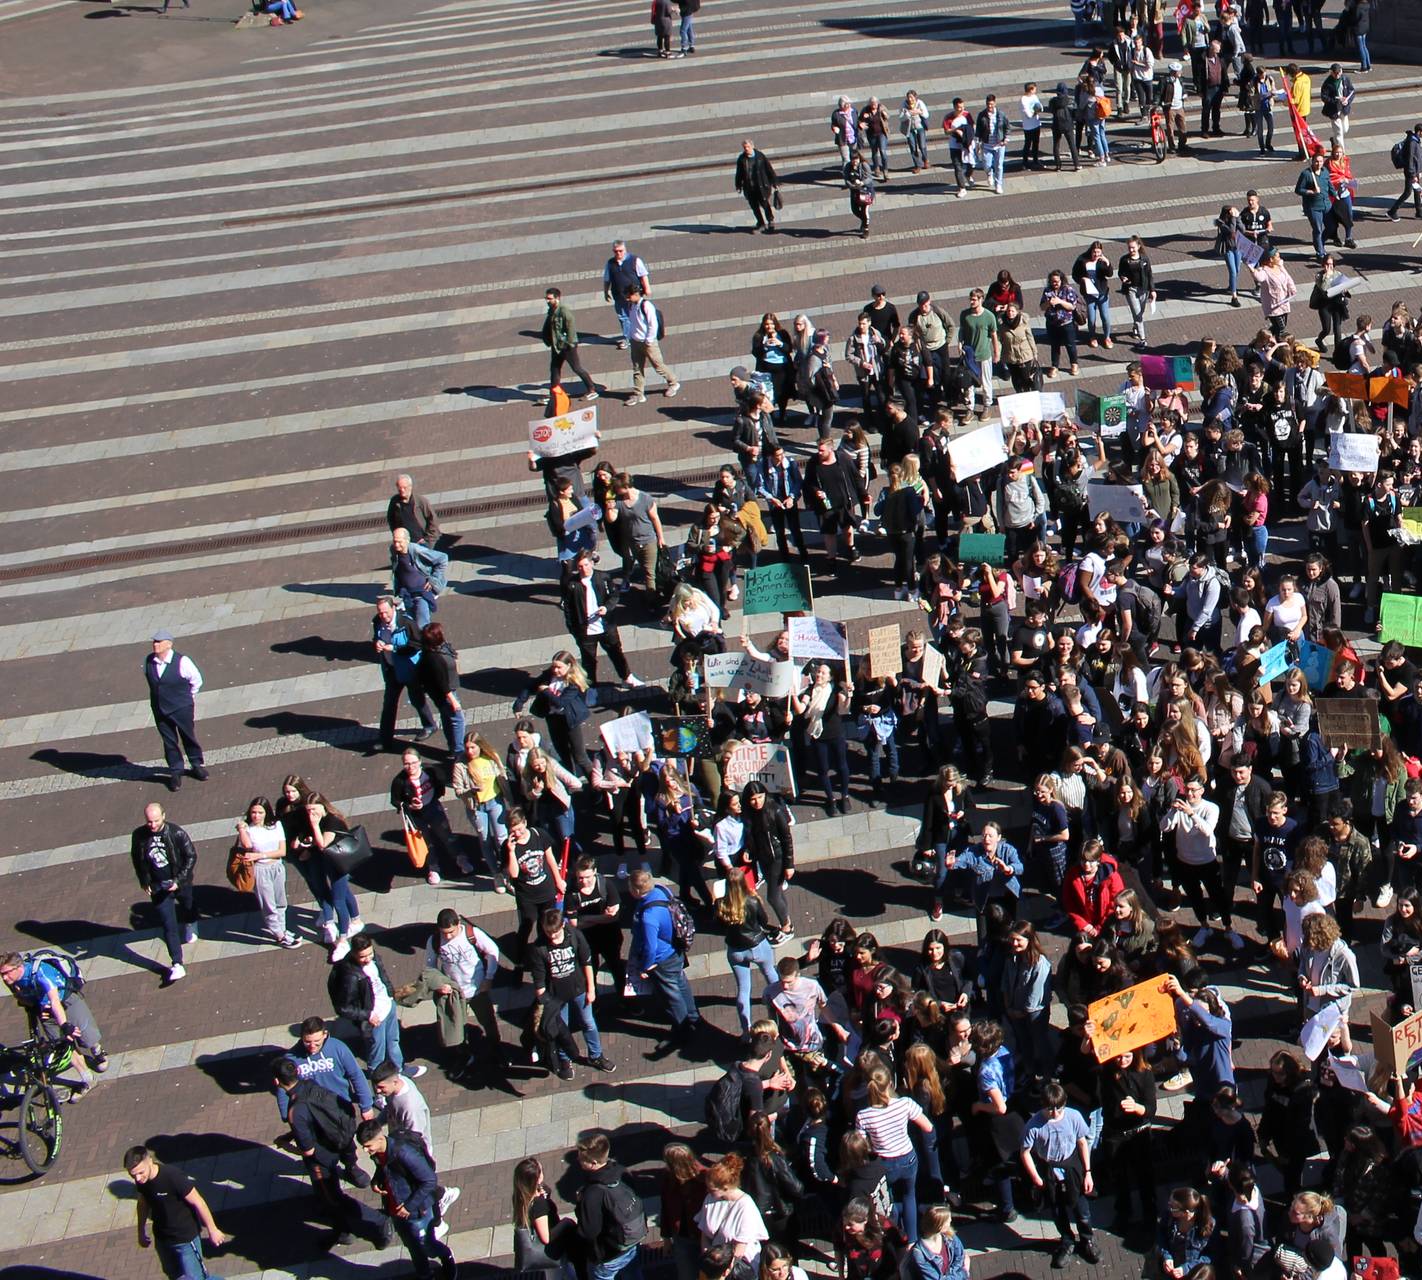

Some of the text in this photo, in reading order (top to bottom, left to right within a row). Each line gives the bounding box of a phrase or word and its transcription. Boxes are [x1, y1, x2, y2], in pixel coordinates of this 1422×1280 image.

[746, 569, 772, 589] Hört
[735, 746, 767, 761] TIME
[297, 1058, 334, 1075] BOSS
